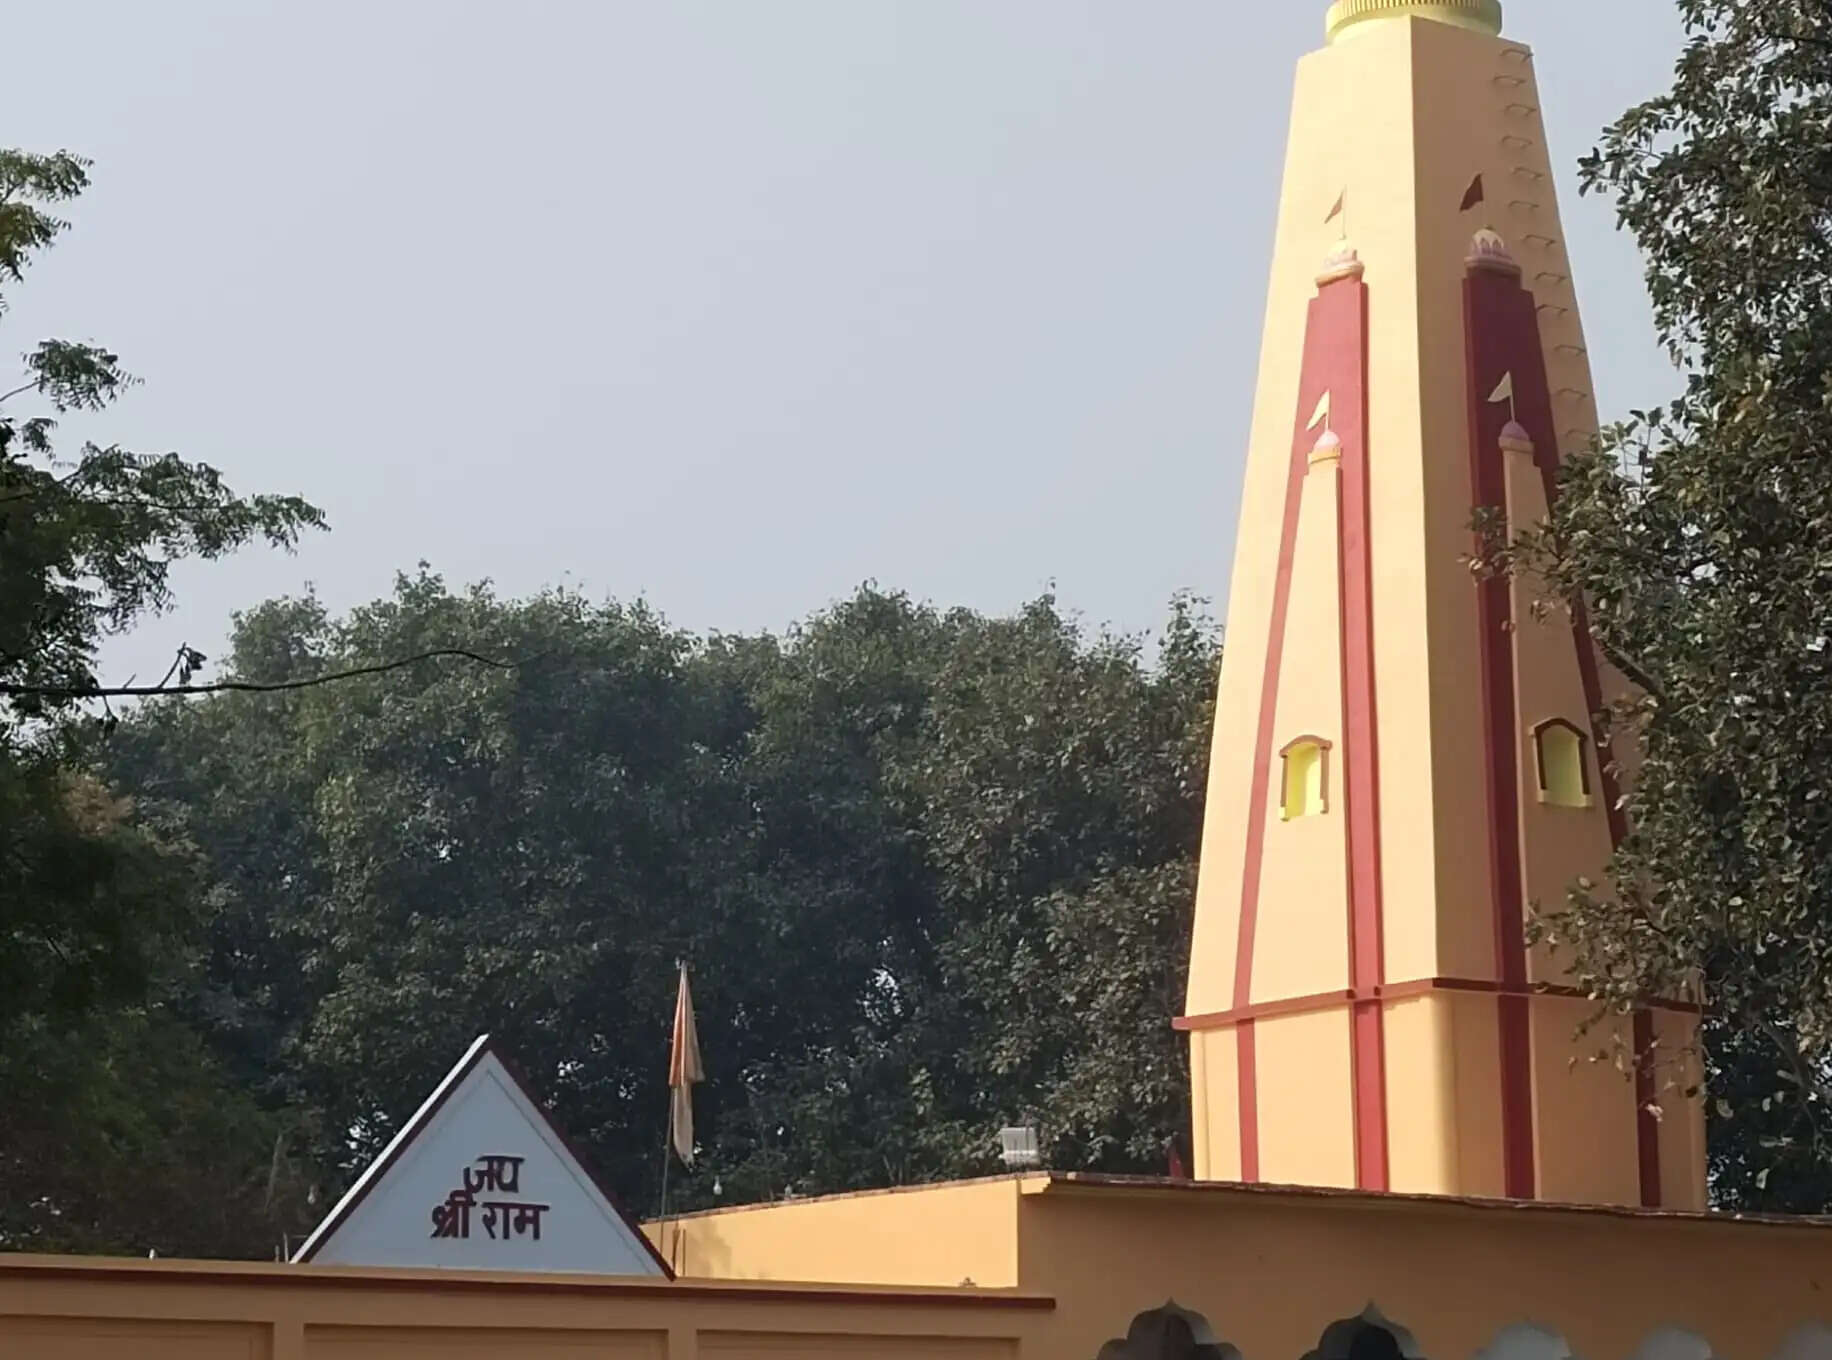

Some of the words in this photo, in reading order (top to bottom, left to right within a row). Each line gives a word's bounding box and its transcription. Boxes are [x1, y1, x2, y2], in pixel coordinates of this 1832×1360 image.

[463, 1155, 525, 1194] जय
[430, 1189, 477, 1239] श्री
[481, 1201, 550, 1241] राम
